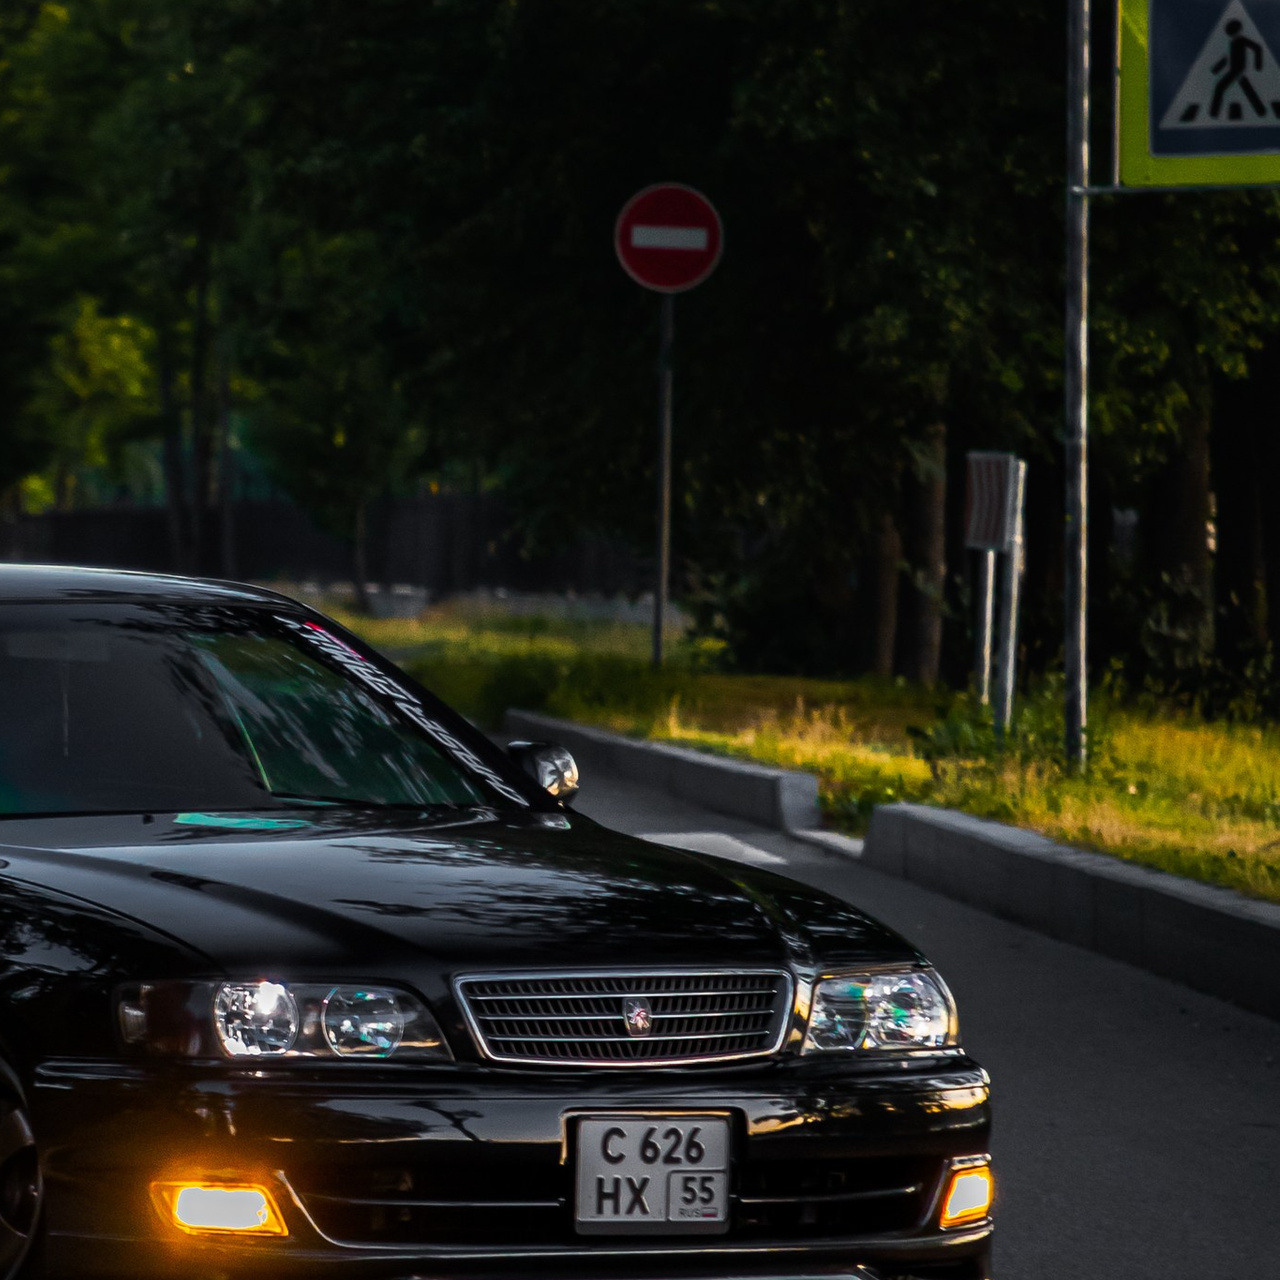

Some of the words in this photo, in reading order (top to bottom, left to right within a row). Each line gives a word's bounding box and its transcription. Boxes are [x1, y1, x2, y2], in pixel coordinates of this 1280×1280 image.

[395, 701, 530, 806] CHASER
[601, 1126, 627, 1165] C
[640, 1126, 705, 1165] 626
[596, 1175, 650, 1215] HX
[681, 1176, 715, 1205] 55
[678, 1207, 701, 1218] RUS
